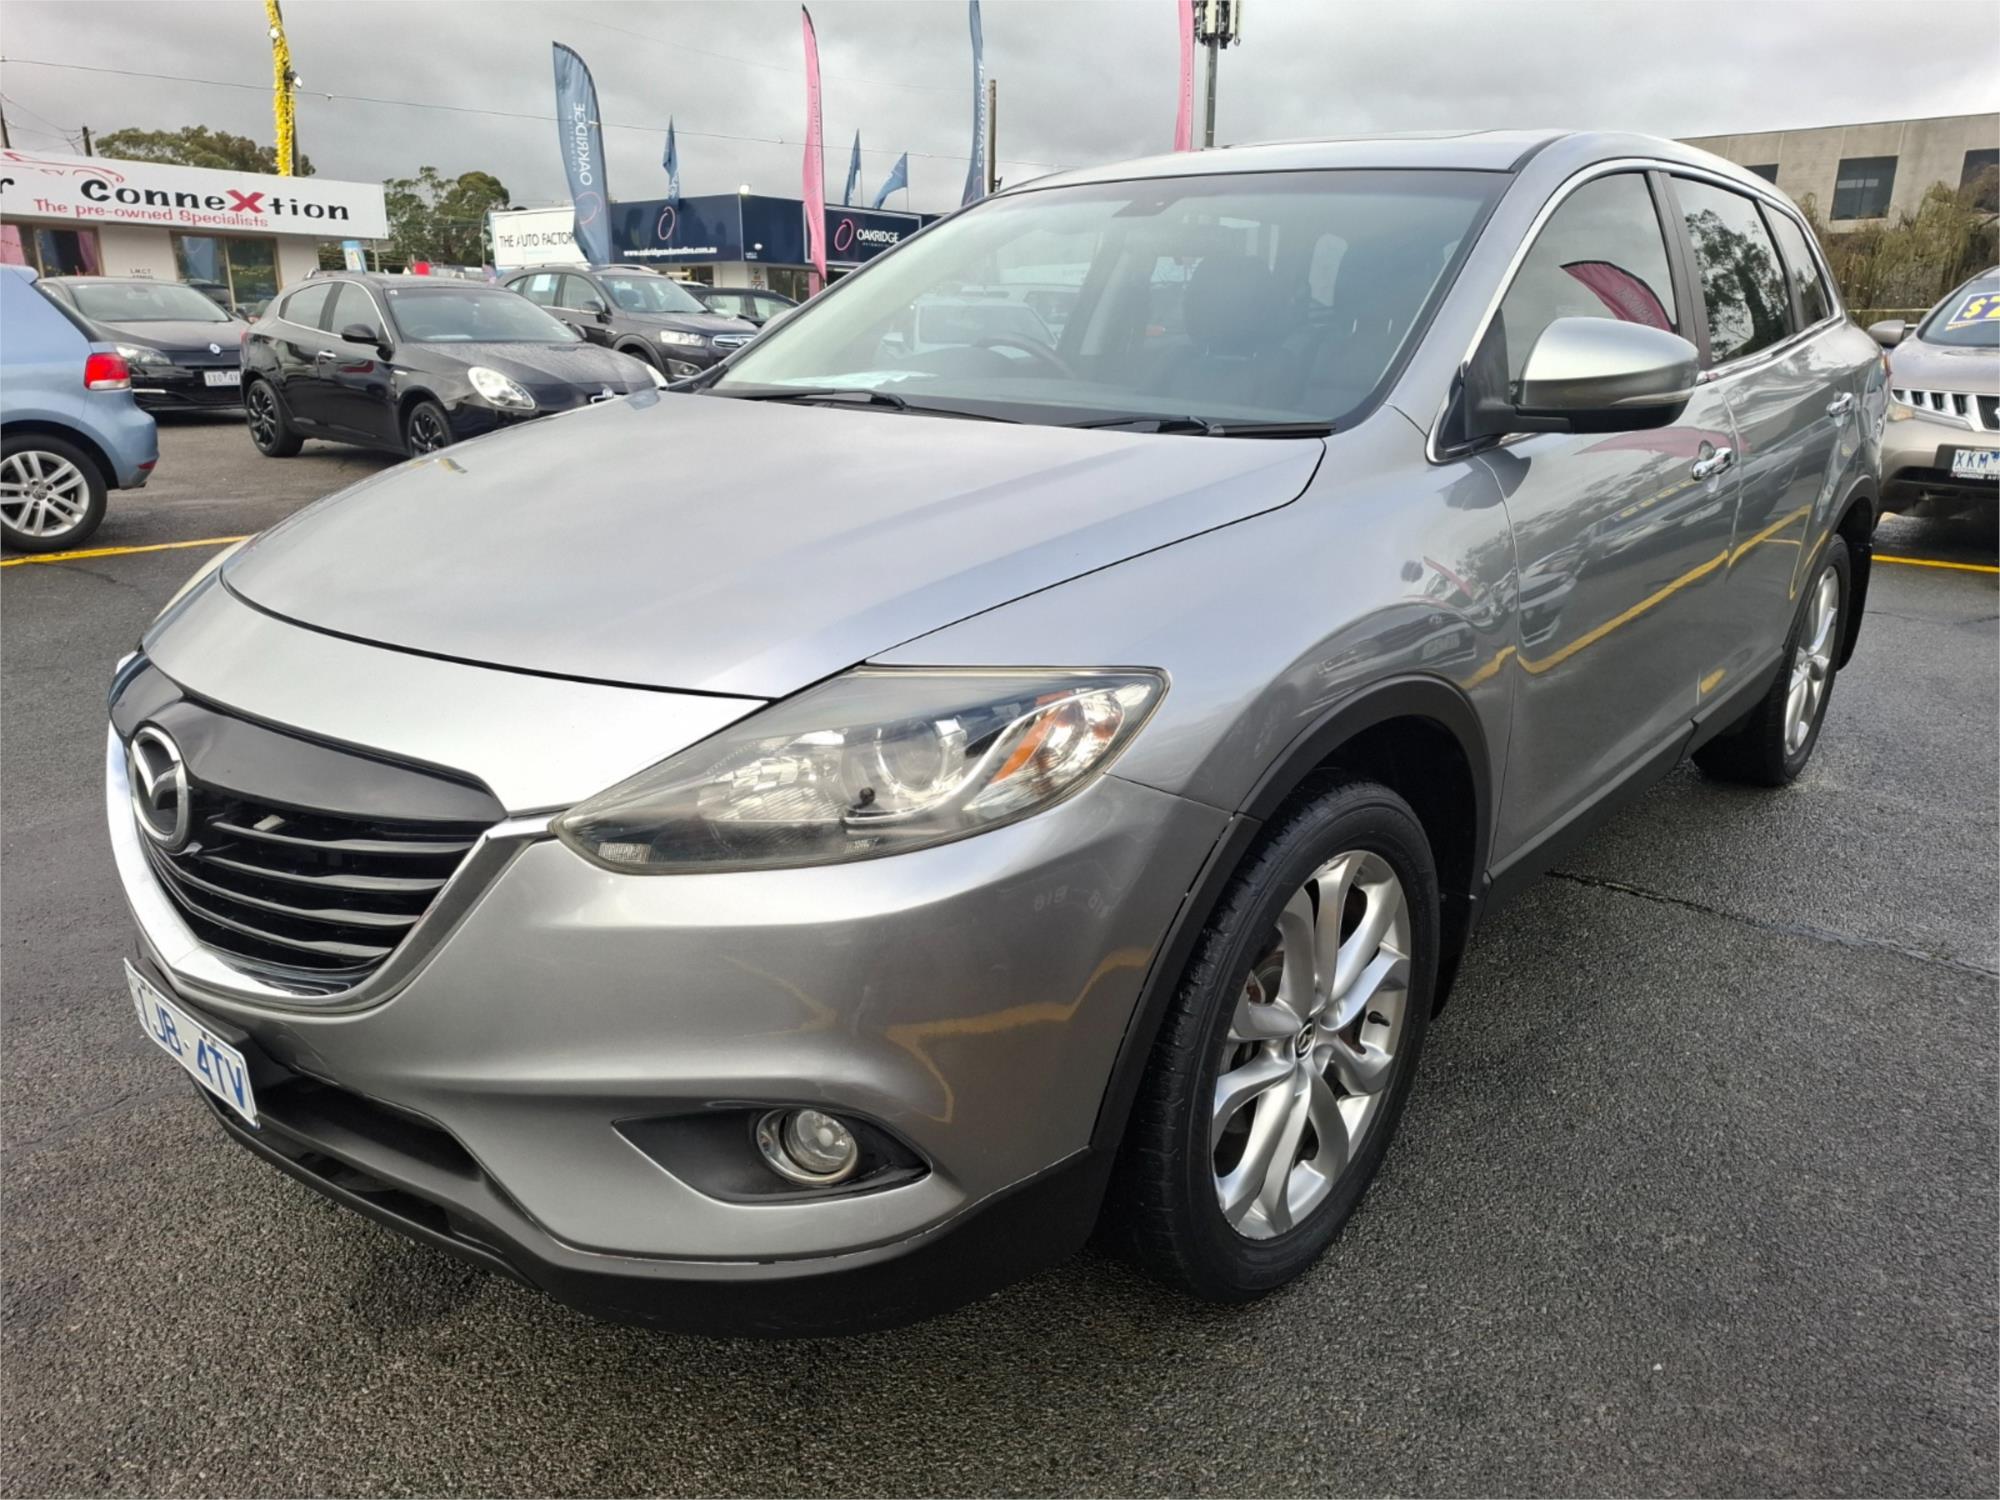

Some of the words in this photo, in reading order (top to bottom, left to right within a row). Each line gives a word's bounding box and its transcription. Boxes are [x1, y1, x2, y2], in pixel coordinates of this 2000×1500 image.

[34, 199, 68, 213] The
[75, 205, 173, 221] pre-owned
[179, 209, 268, 227] Specialists
[499, 234, 514, 248] THE
[856, 228, 899, 244] OAKRIDGE
[1955, 451, 1989, 469] XKM
